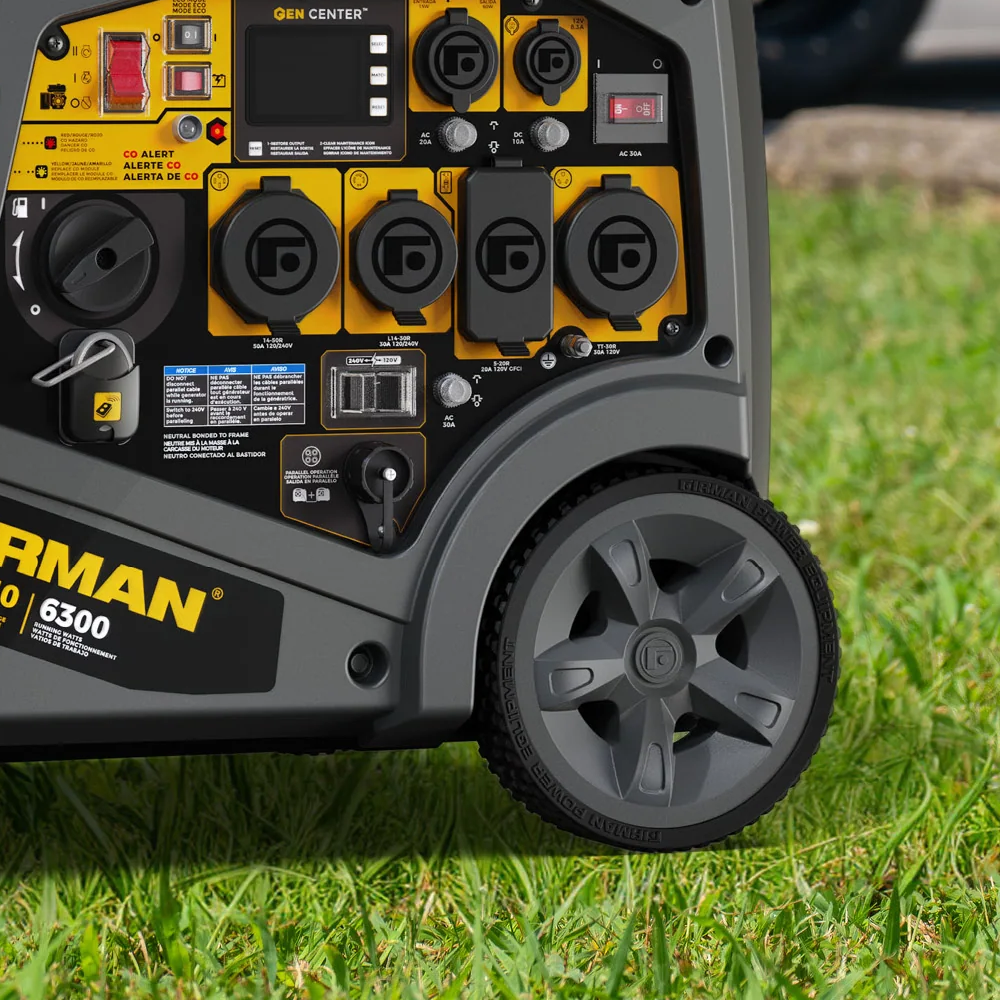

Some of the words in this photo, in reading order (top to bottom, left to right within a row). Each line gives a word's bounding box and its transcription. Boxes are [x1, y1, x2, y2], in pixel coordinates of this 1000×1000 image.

[274, 7, 304, 21] GEN
[123, 150, 138, 158] CO
[40, 599, 110, 638] 6300
[34, 622, 62, 635] RUNNING
[63, 631, 83, 642] WATTS
[31, 633, 52, 644] VATIOS
[62, 644, 89, 657] TRABAJO
[32, 628, 52, 638] WATTS
[62, 638, 117, 660] FONCTIONNEMENT
